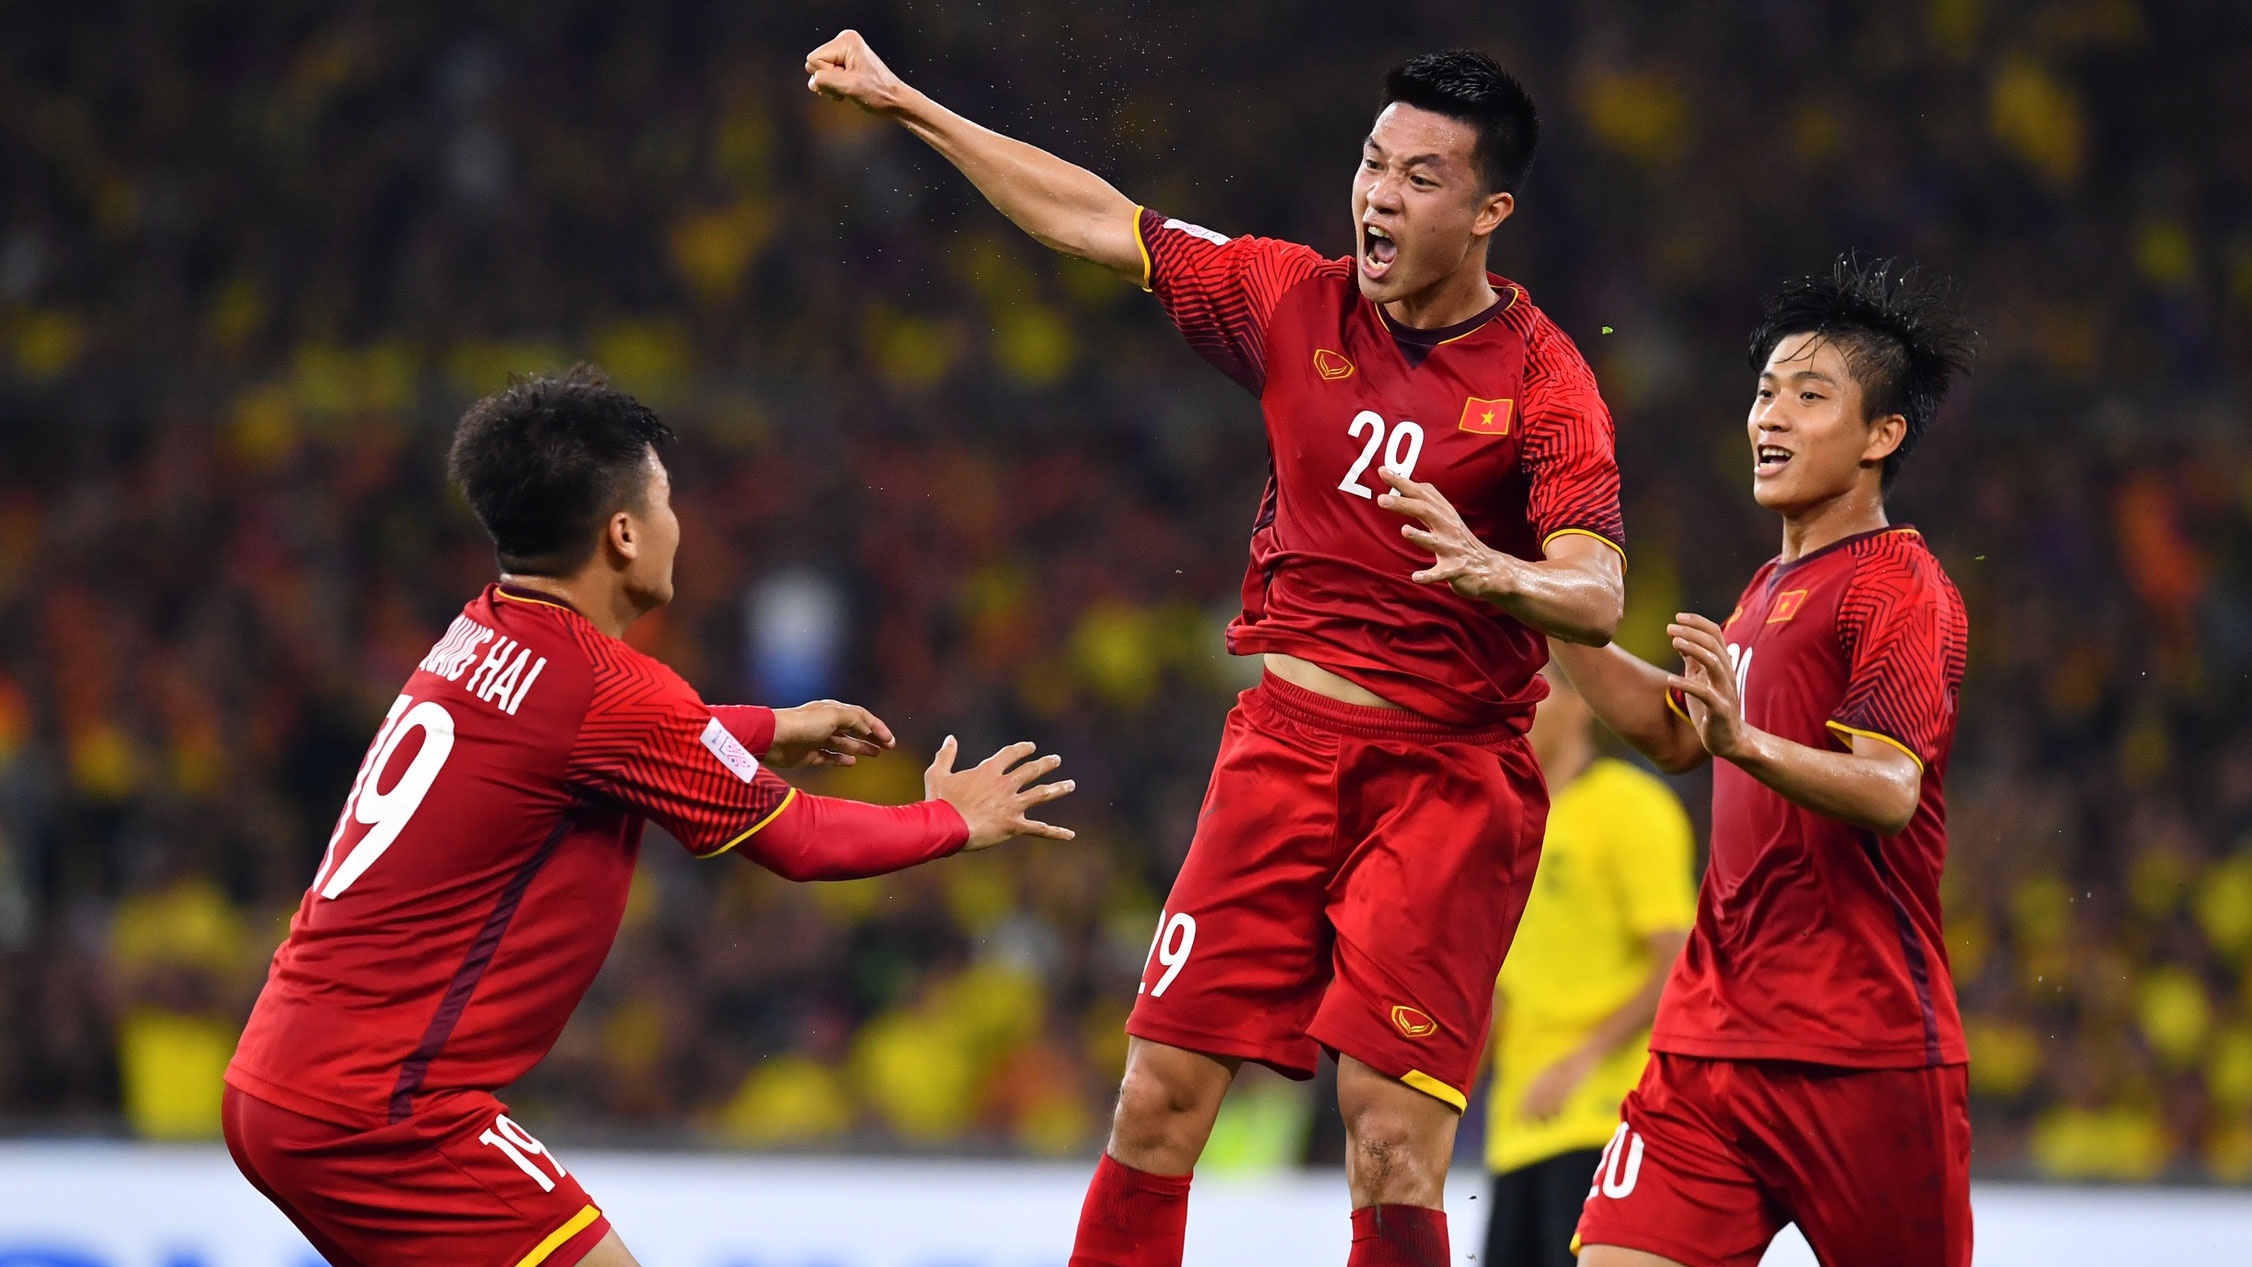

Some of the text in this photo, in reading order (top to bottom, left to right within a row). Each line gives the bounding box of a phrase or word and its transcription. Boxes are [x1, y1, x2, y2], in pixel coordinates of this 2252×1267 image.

[1337, 410, 1425, 499] 29
[465, 635, 548, 716] HAI
[312, 694, 456, 900] 19
[478, 1113, 567, 1193] 19
